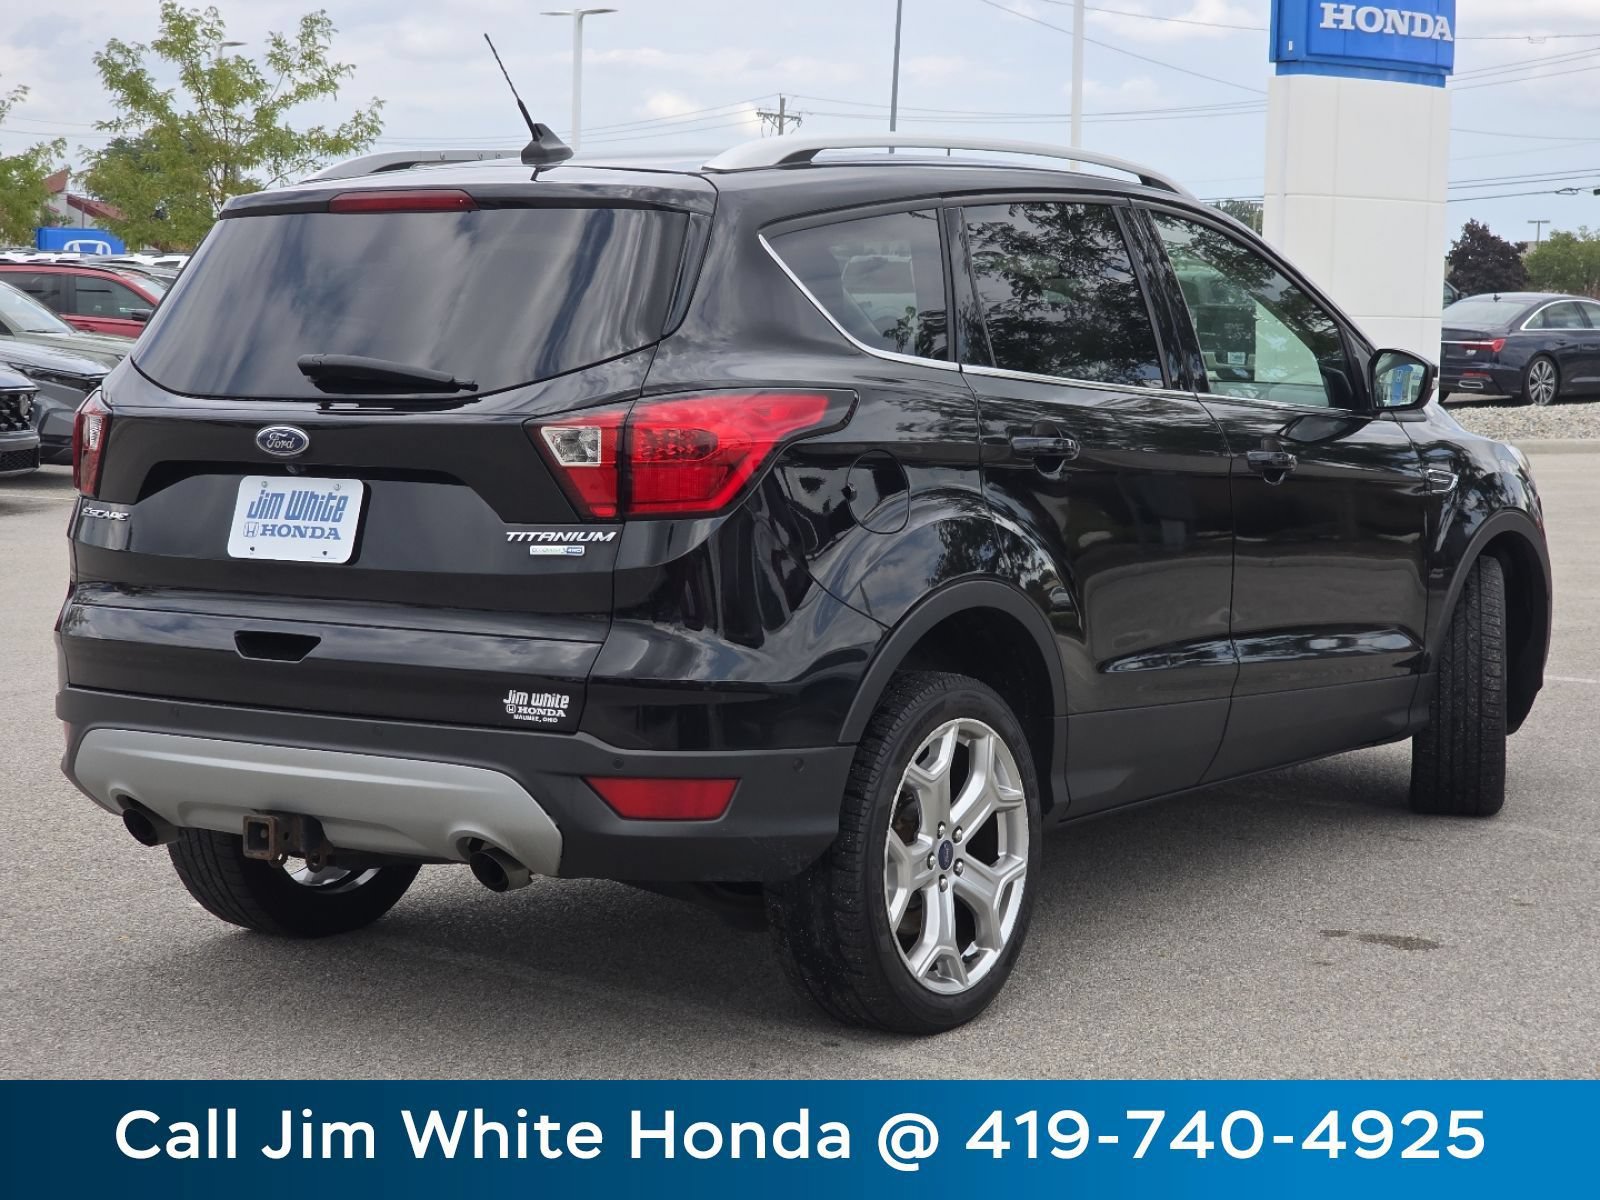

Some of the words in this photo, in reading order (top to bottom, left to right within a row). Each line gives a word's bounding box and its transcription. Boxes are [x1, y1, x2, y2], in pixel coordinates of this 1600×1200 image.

[1319, 2, 1453, 42] HONDA
[266, 431, 295, 449] Ford
[284, 490, 349, 523] White
[260, 523, 341, 541] HONDA
[506, 531, 617, 542] TITANIUM
[502, 689, 529, 706] Jim
[517, 705, 567, 718] HONDA
